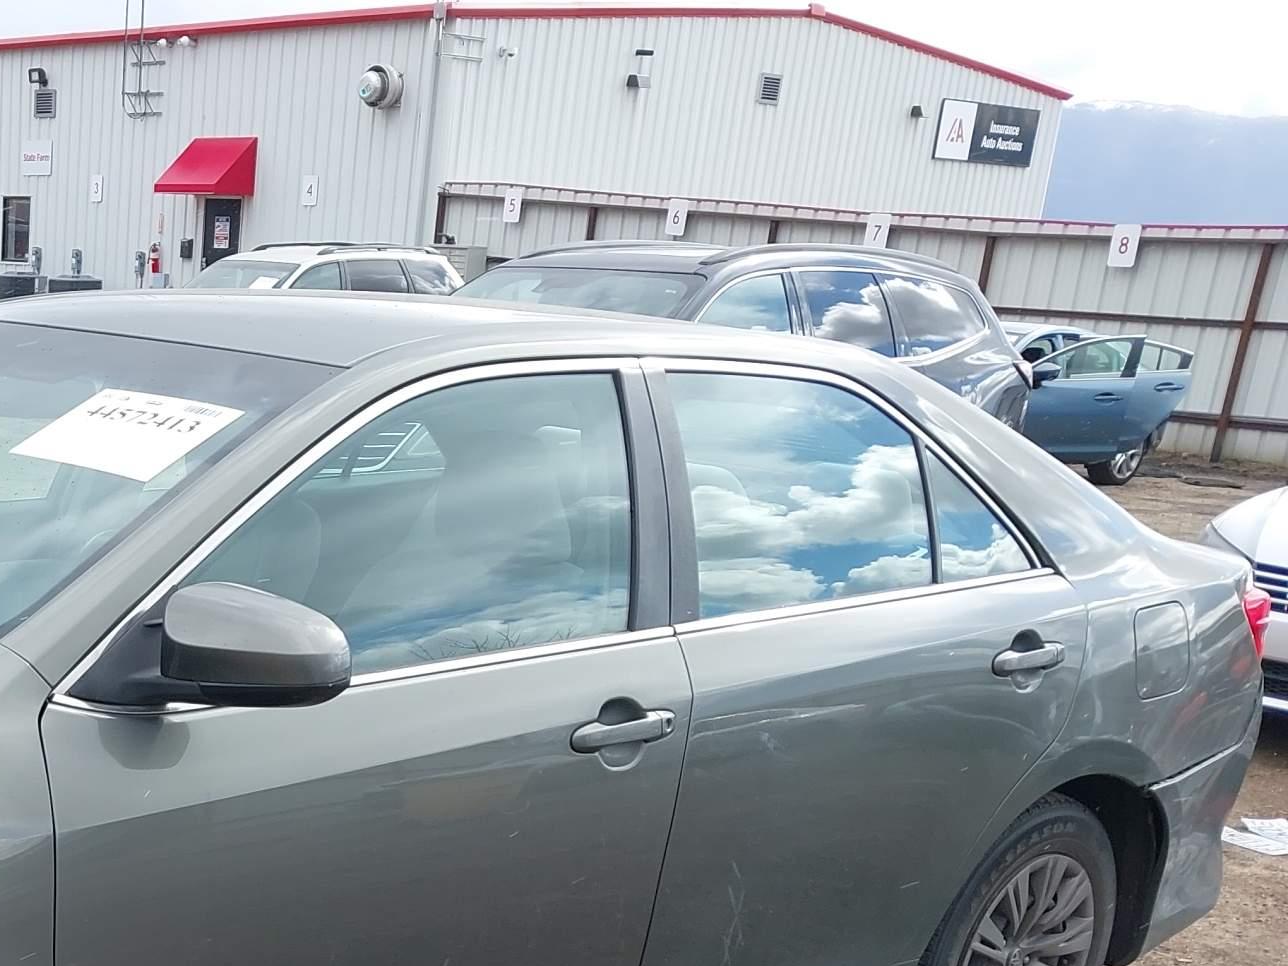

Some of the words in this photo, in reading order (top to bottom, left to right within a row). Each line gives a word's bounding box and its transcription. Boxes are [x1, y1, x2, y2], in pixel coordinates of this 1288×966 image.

[990, 120, 1021, 136] Insurance
[981, 135, 996, 149] Auto
[996, 138, 1024, 152] Auctions
[23, 153, 37, 162] State
[37, 153, 50, 162] Farm
[306, 183, 313, 196] 4
[509, 198, 516, 213] 5
[672, 210, 680, 224] 6
[873, 225, 882, 241] 7
[1118, 236, 1130, 255] 8
[86, 404, 202, 434] 44572413
